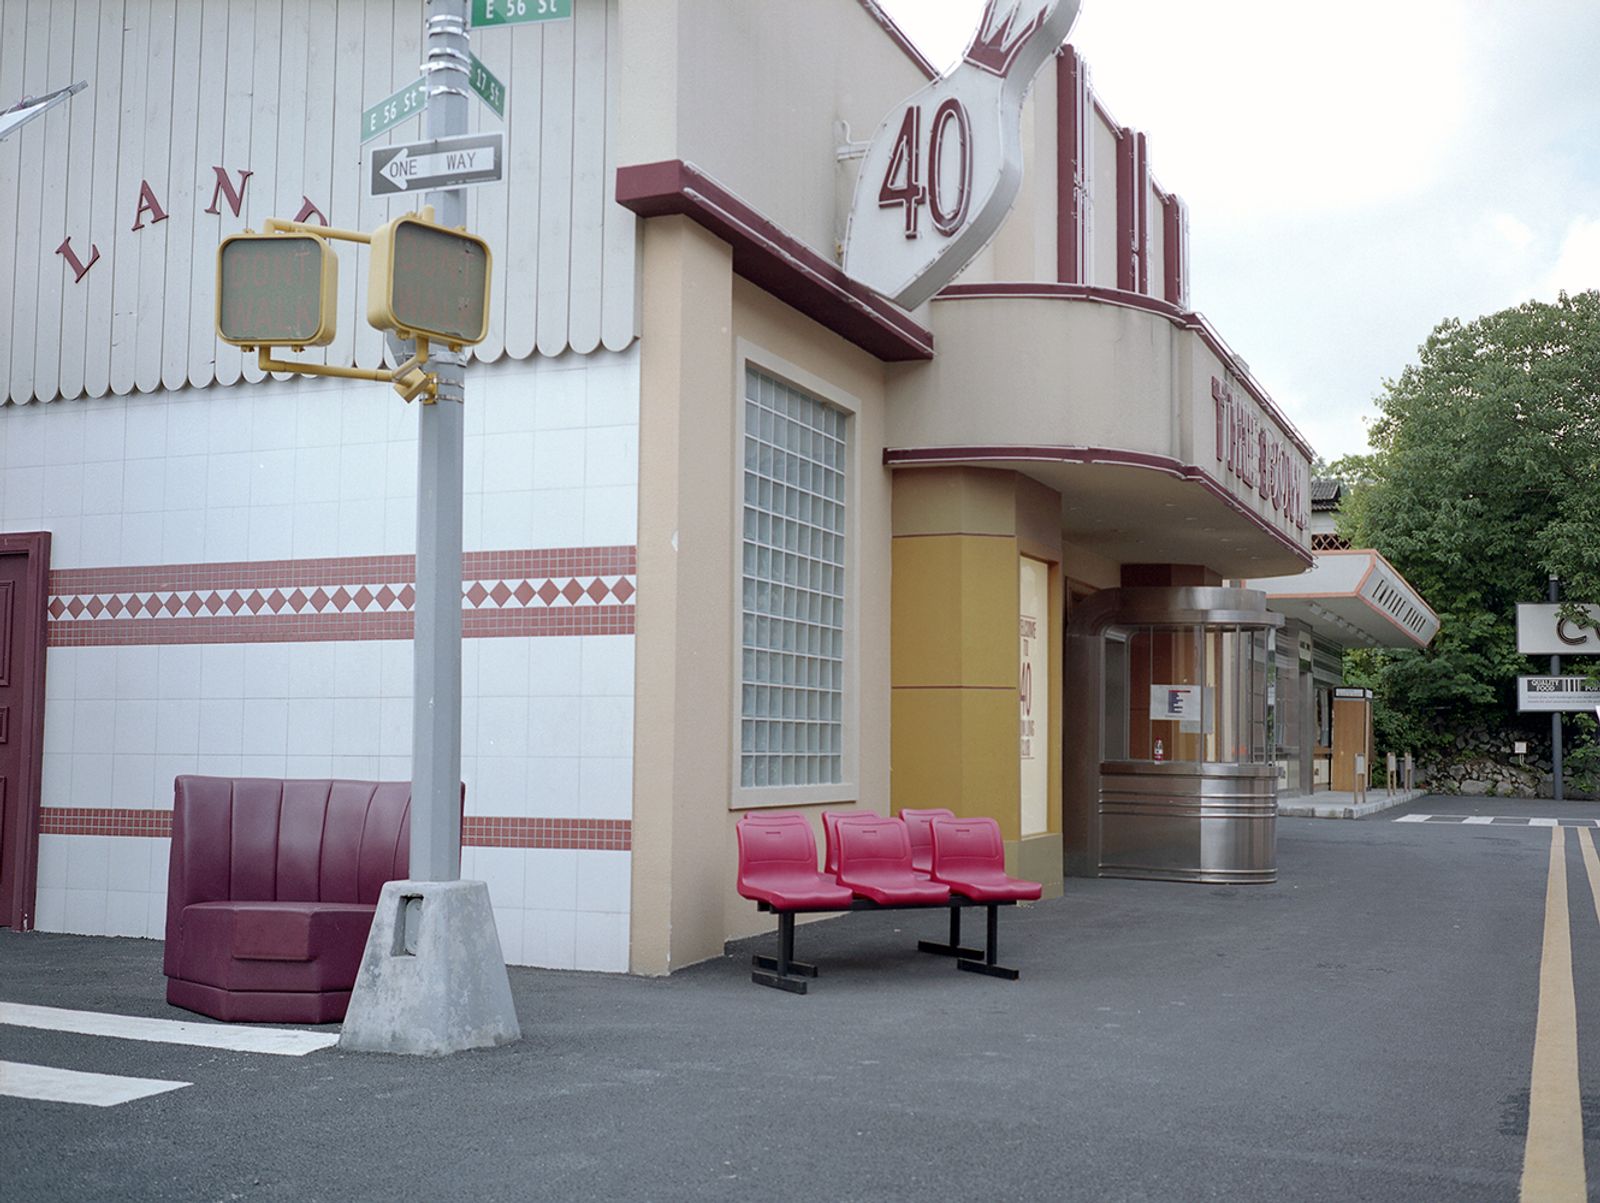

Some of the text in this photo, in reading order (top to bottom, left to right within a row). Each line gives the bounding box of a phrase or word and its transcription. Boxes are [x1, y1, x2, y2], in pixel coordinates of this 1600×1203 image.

[486, 0, 557, 19] E 56 St
[476, 68, 499, 106] 17 St
[370, 91, 417, 131] E 56 St
[389, 151, 477, 178] ONE WAY
[878, 97, 973, 240] 40
